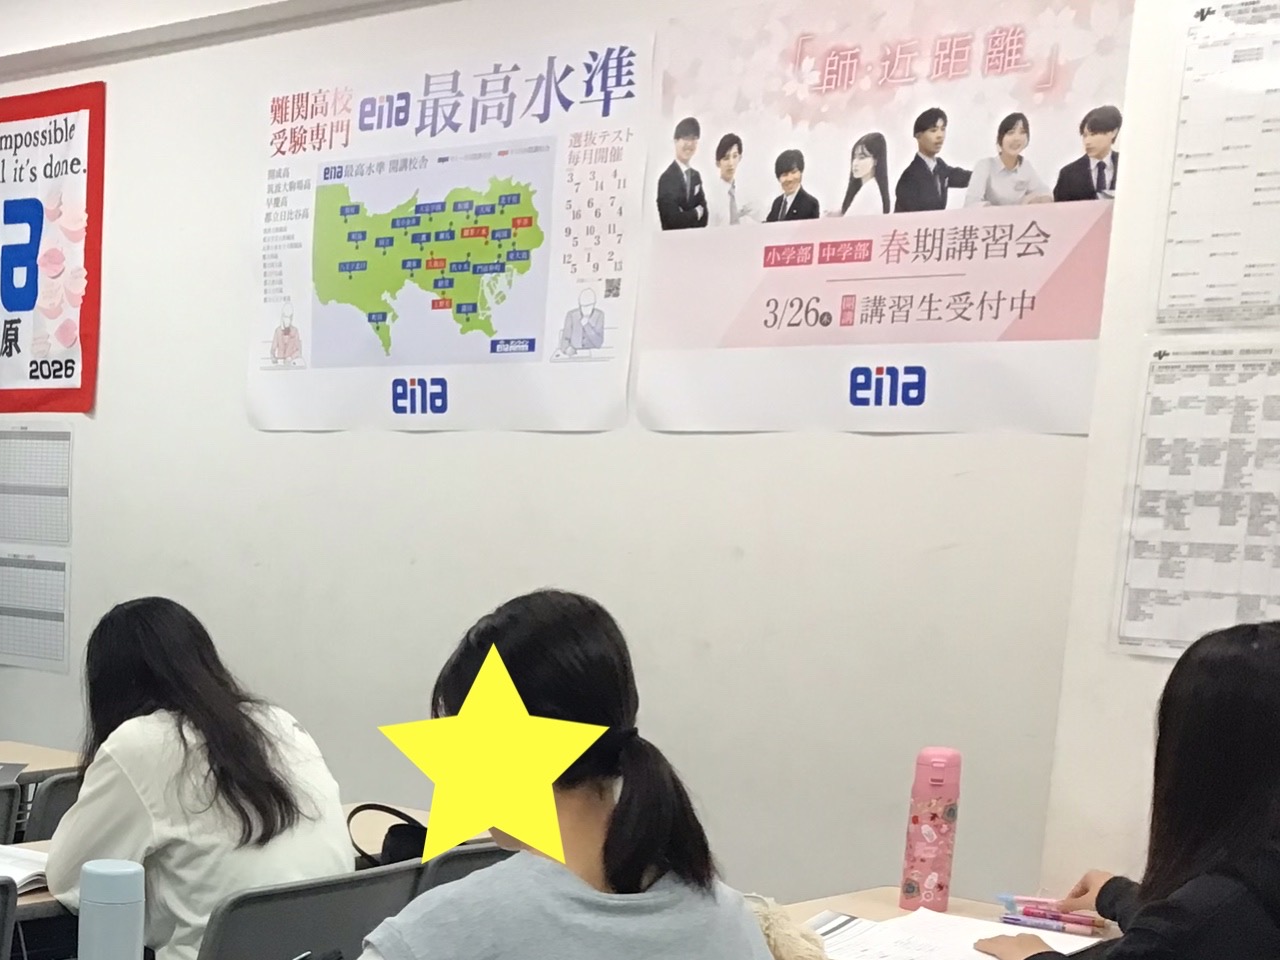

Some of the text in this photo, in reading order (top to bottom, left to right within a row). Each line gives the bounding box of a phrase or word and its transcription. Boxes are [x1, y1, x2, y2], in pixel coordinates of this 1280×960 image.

[269, 86, 354, 126] 難関高校
[358, 45, 639, 138] ena 最高水準
[269, 118, 351, 158] 受験専門
[567, 146, 624, 166] 毎月開催
[568, 127, 634, 149] 選抜テスト
[12, 157, 38, 183] it's
[43, 153, 88, 181] done.
[344, 162, 385, 178] 最高水準
[388, 155, 428, 174] 開講校舎
[766, 220, 1051, 265] 小学部 中学部 春期講習会
[763, 296, 821, 329] 3/26
[859, 288, 1037, 326] 講習生受付中
[29, 358, 76, 380] 2026
[849, 365, 927, 406] ena
[392, 377, 448, 414] ena
